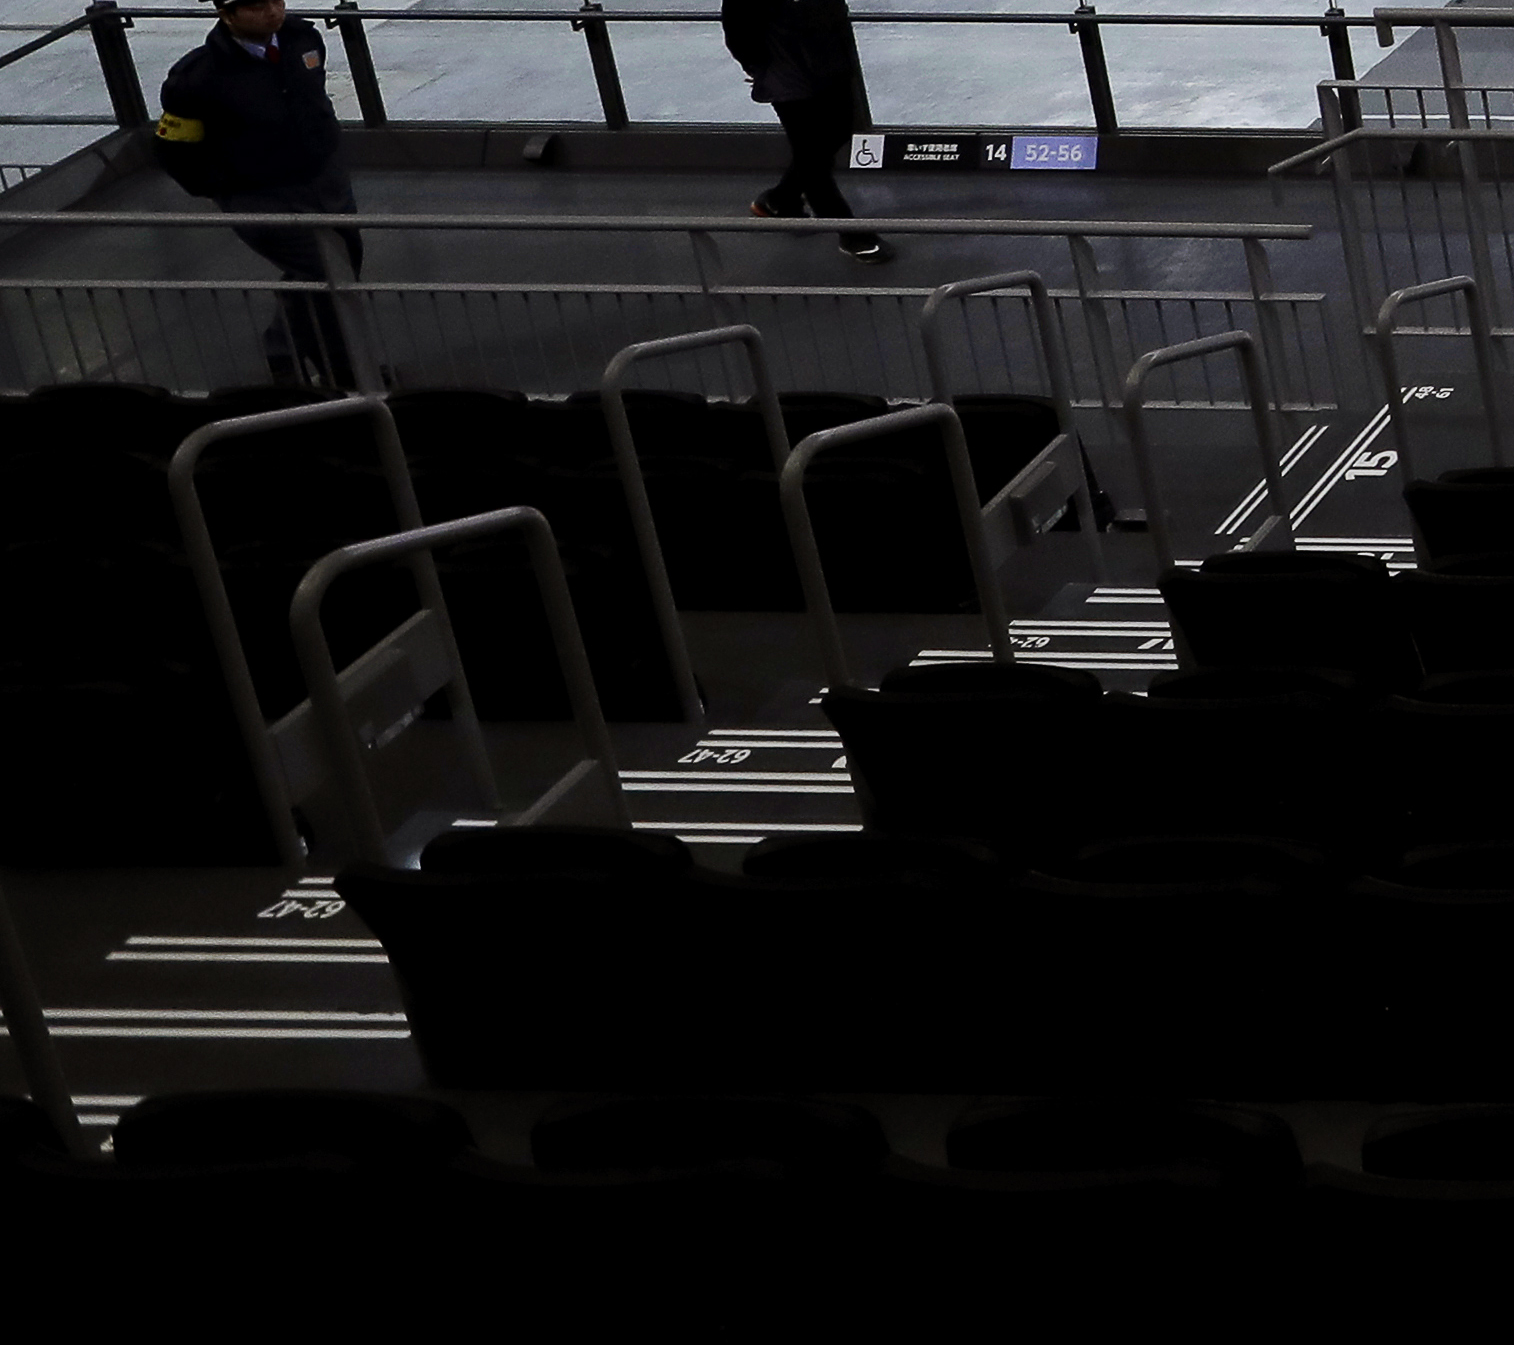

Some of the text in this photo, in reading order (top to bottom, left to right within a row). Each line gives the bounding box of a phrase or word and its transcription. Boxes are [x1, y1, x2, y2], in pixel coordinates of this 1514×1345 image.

[985, 143, 1084, 163] 14 52-56
[1345, 450, 1399, 481] 15
[678, 748, 752, 765] 62-47
[256, 900, 347, 920] 62-47
